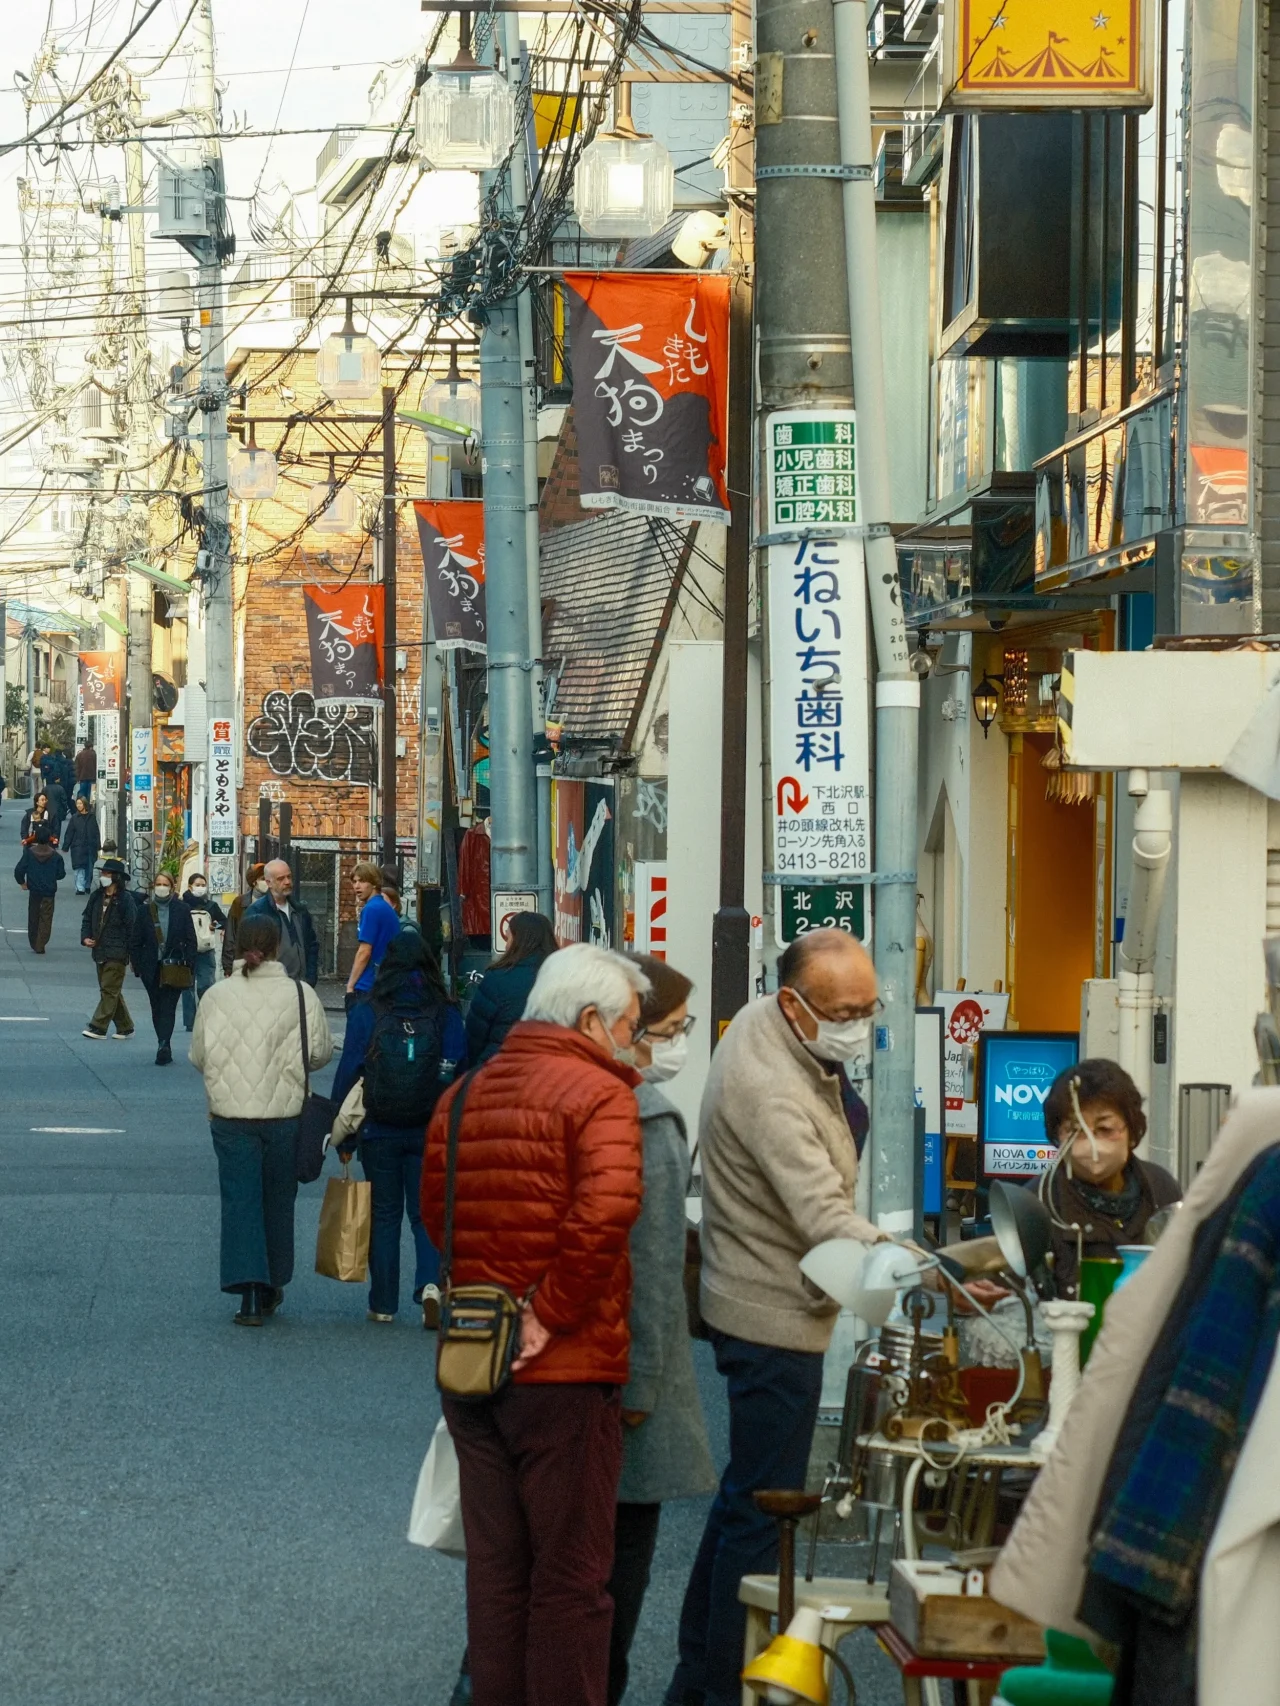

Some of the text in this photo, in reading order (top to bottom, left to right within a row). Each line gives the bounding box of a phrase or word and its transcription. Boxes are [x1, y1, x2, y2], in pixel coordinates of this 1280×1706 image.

[591, 323, 665, 484] 天狗まつり
[775, 423, 853, 446] 歯科
[775, 449, 853, 471] 小児歯科
[775, 475, 853, 497] 矯正歯科
[777, 501, 853, 523] 口腔外科
[318, 609, 357, 690] 天狗まつり
[793, 537, 845, 772] たねいち歯科
[135, 731, 150, 739] Zoff
[213, 721, 231, 742] 質
[137, 744, 148, 766] ゾフ
[215, 759, 230, 817] ともえや
[812, 785, 865, 799] 下北沢駅
[822, 802, 859, 815] 西口
[777, 819, 866, 833] 井の頭線改札先
[777, 835, 866, 848] ローソン先角入る
[777, 852, 867, 870] 3413-8218
[793, 891, 854, 910] 北沢
[796, 916, 852, 935] 2-25
[994, 1084, 1052, 1107] NOV
[993, 1148, 1025, 1159] NOVA
[992, 1161, 1039, 1171] バイリンガル
